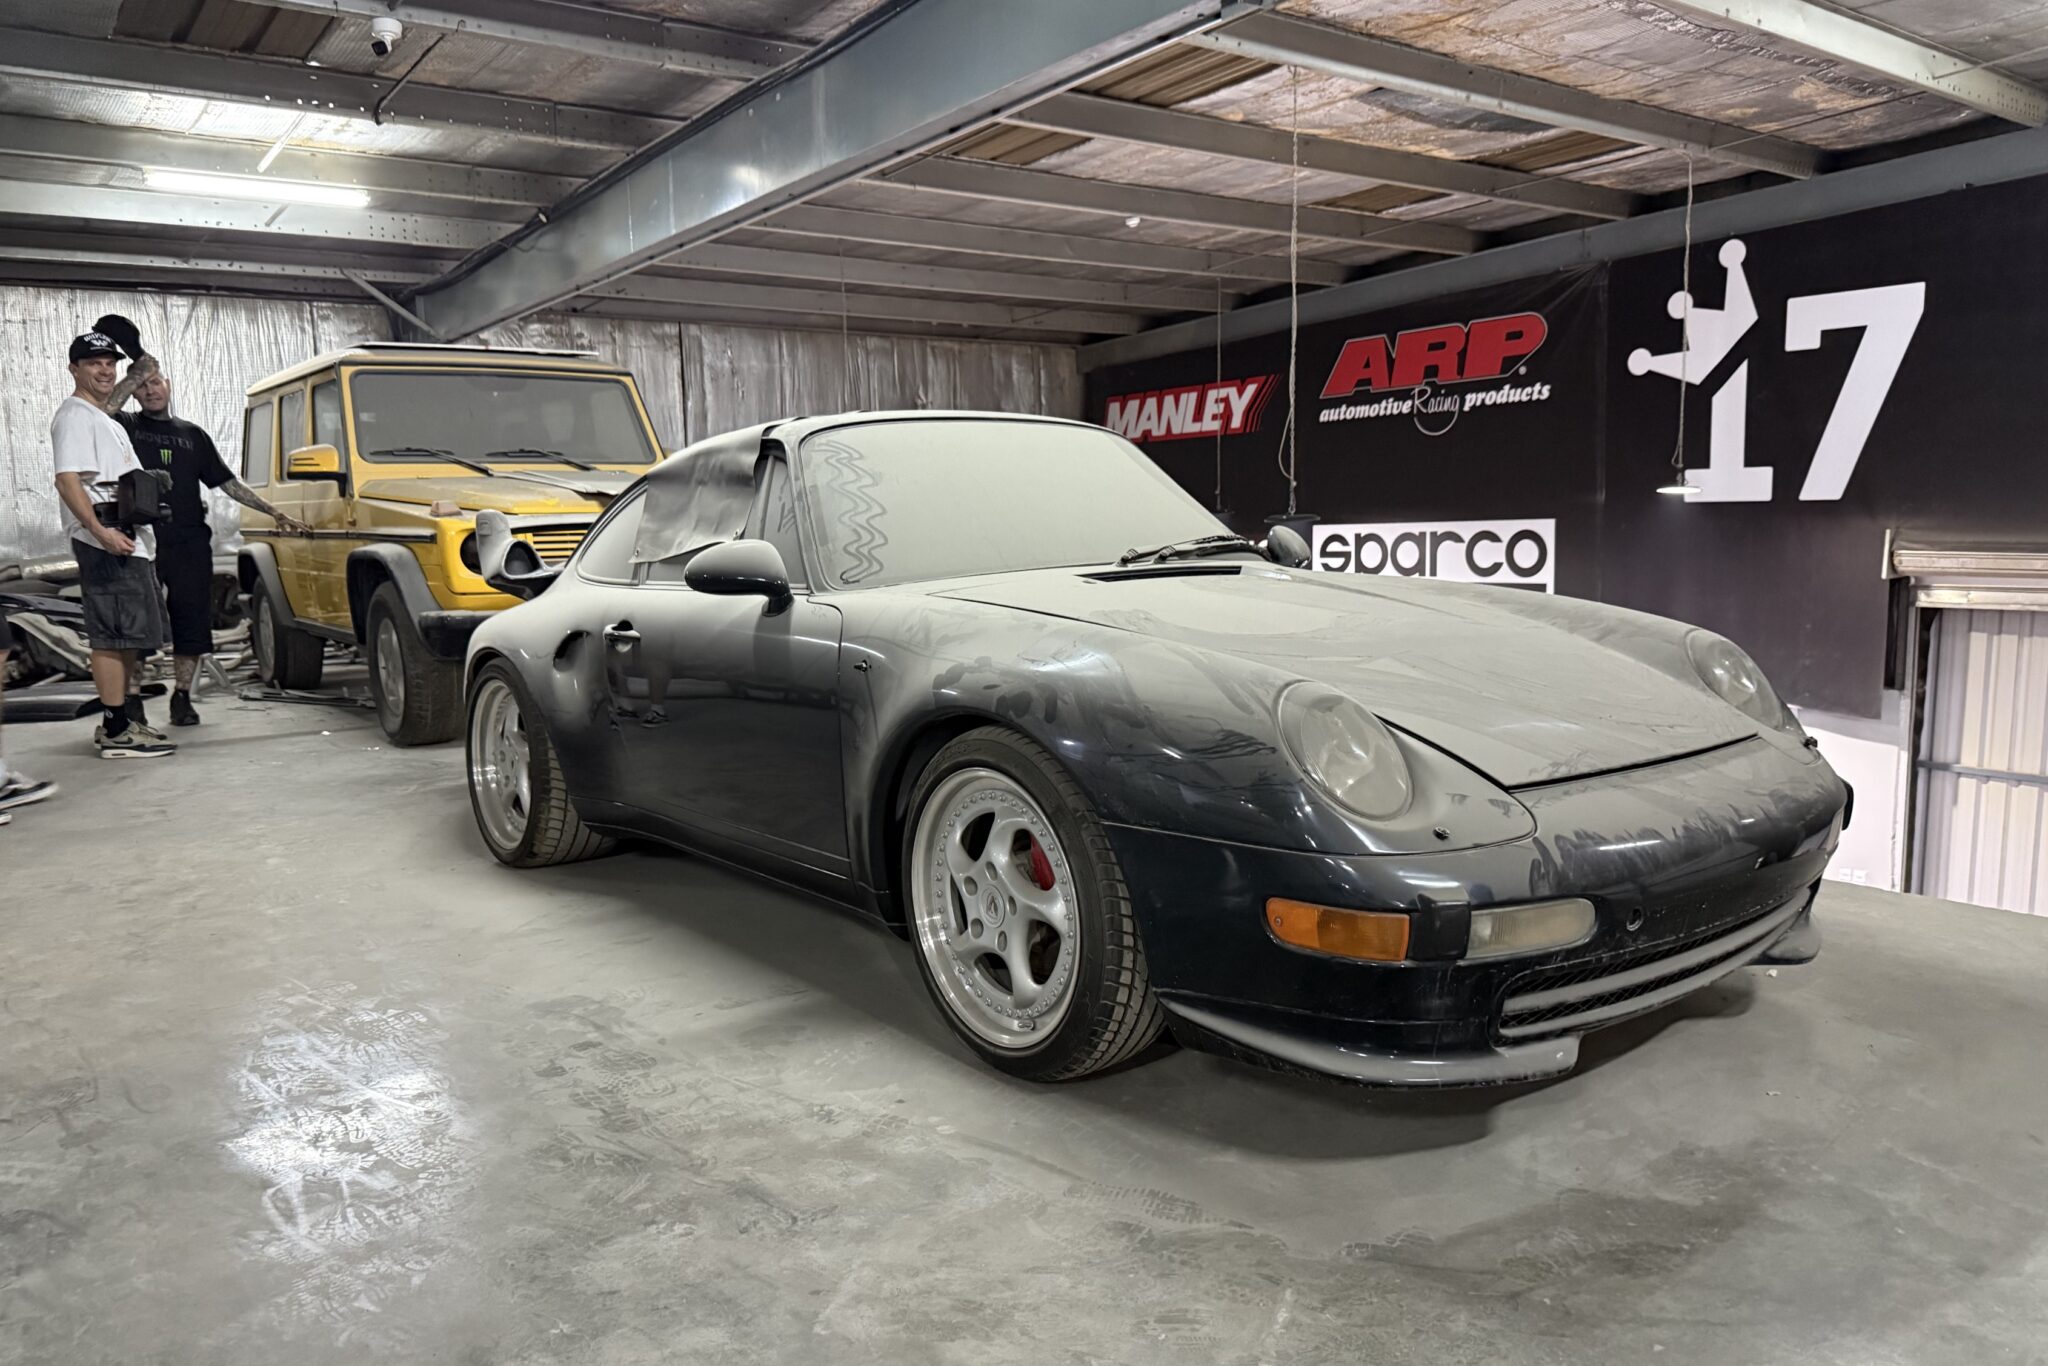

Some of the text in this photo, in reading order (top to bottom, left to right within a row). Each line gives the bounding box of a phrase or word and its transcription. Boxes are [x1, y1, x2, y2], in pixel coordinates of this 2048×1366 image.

[1319, 311, 1548, 399] ARP
[1105, 382, 1259, 440] MANLEY
[1319, 381, 1551, 436] automotive Racing products
[1684, 281, 1926, 502] 17
[1319, 529, 1548, 578] sparco
